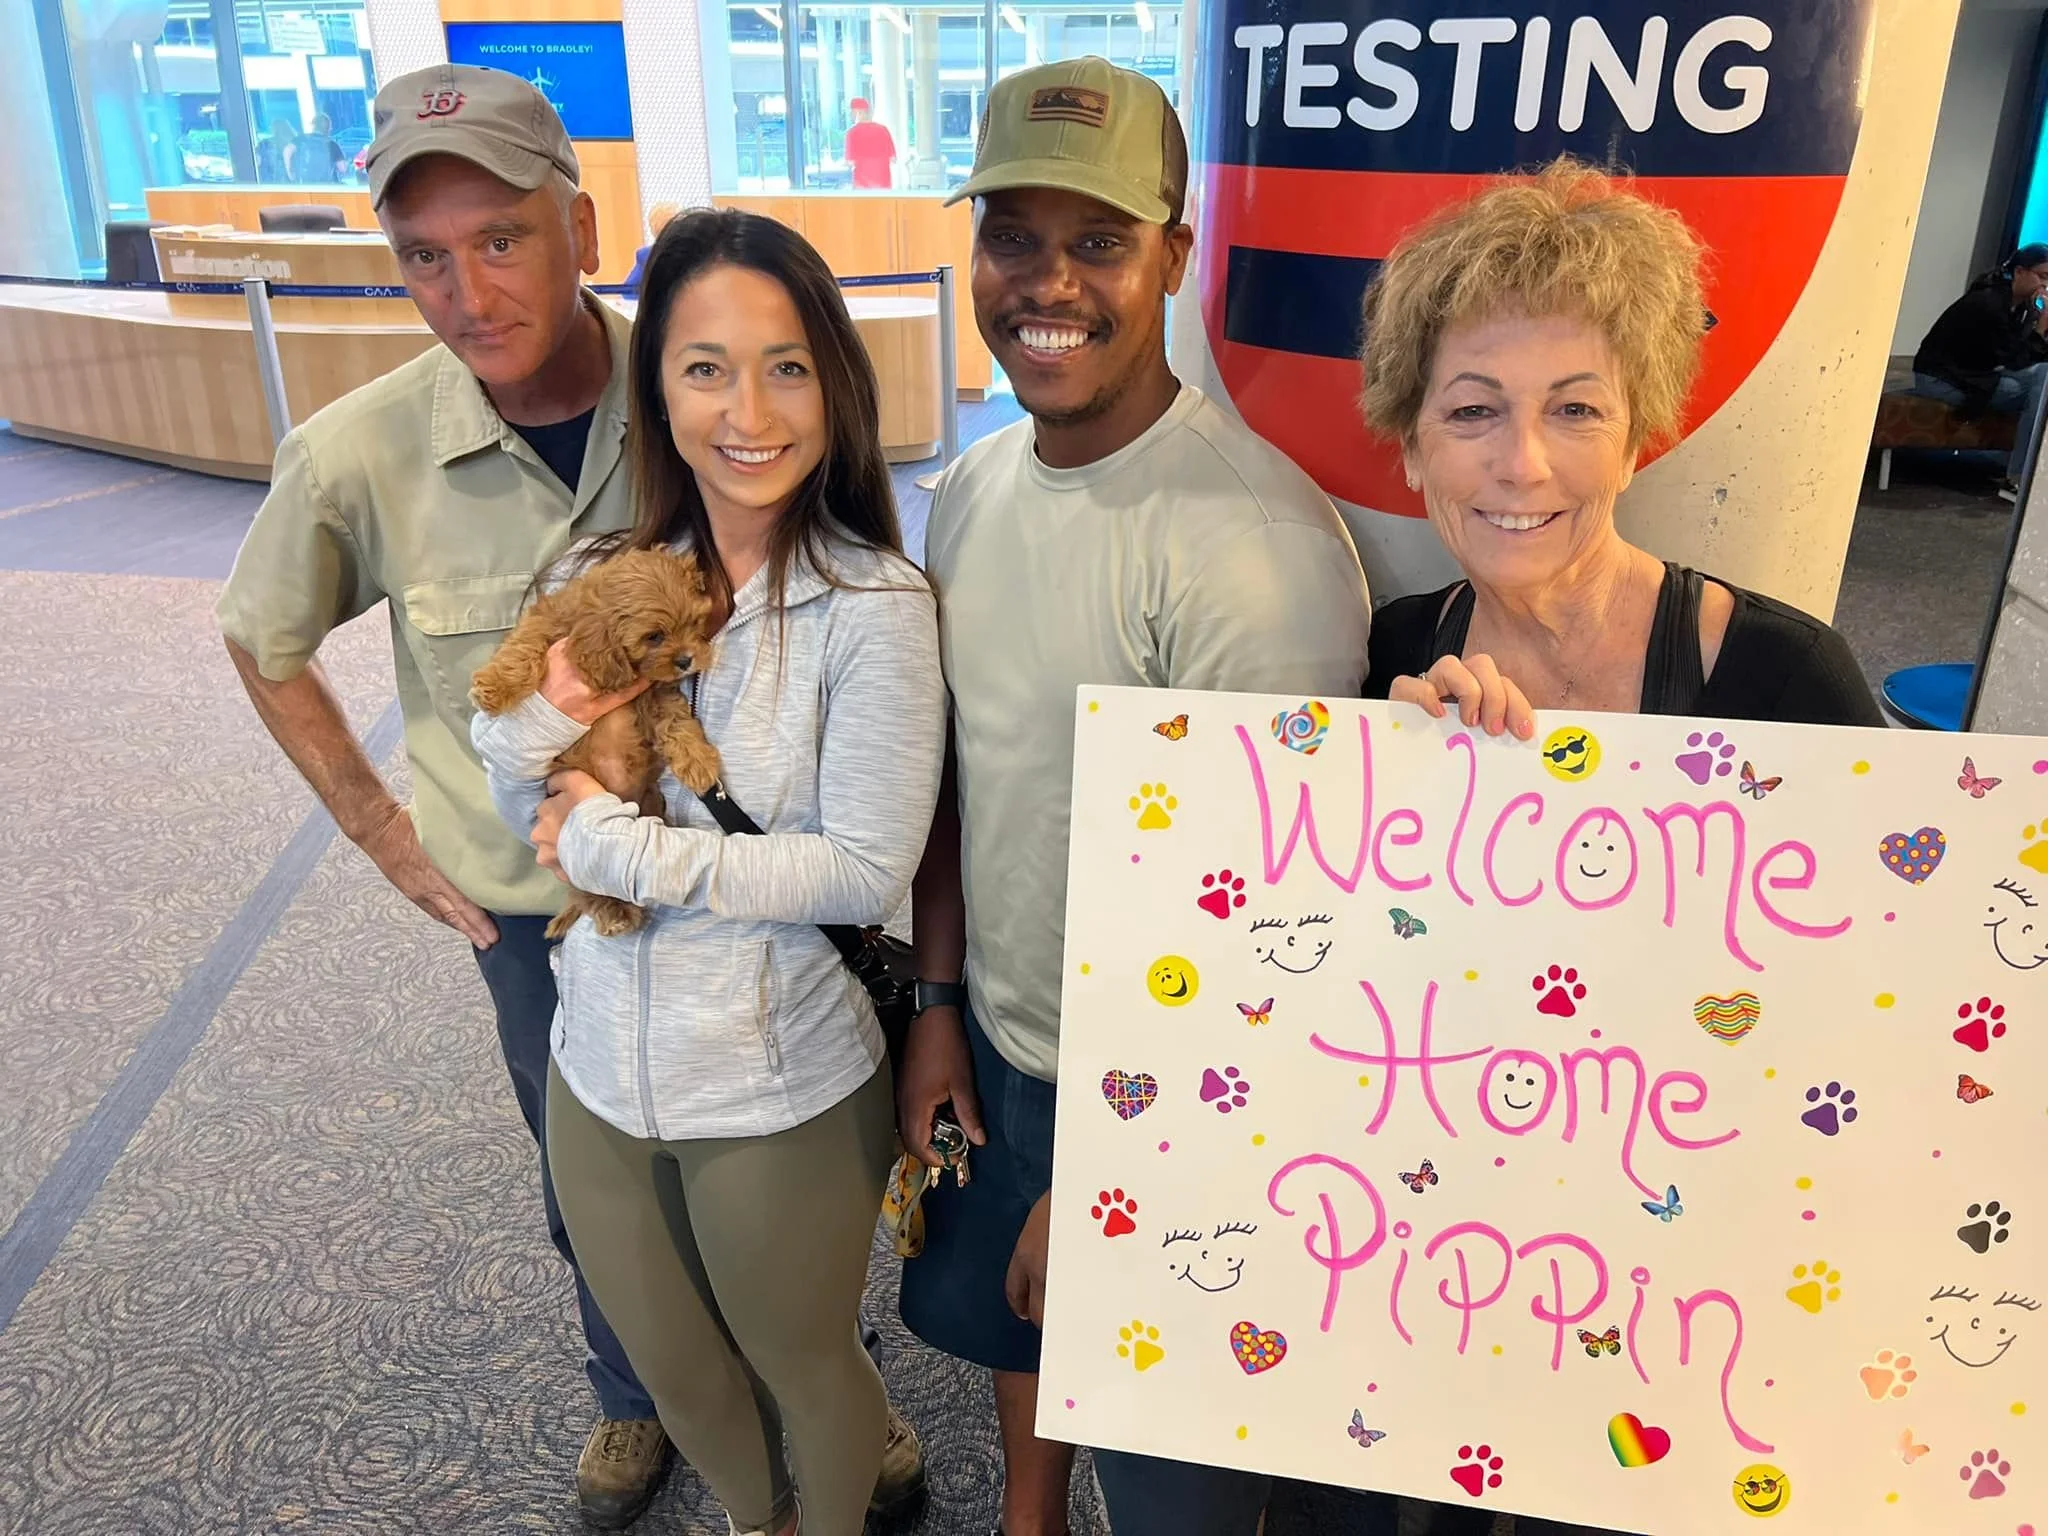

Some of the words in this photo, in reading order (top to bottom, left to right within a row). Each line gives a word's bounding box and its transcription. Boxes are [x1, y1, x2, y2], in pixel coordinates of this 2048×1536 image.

[479, 44, 528, 54] WELCOME
[531, 44, 544, 54] TO
[546, 44, 593, 54] BRADLEY!
[1233, 15, 1774, 134] TESTING
[1234, 713, 1853, 972] Welcome
[1308, 980, 1740, 1200] Home
[1267, 1153, 1776, 1454] Pippin
